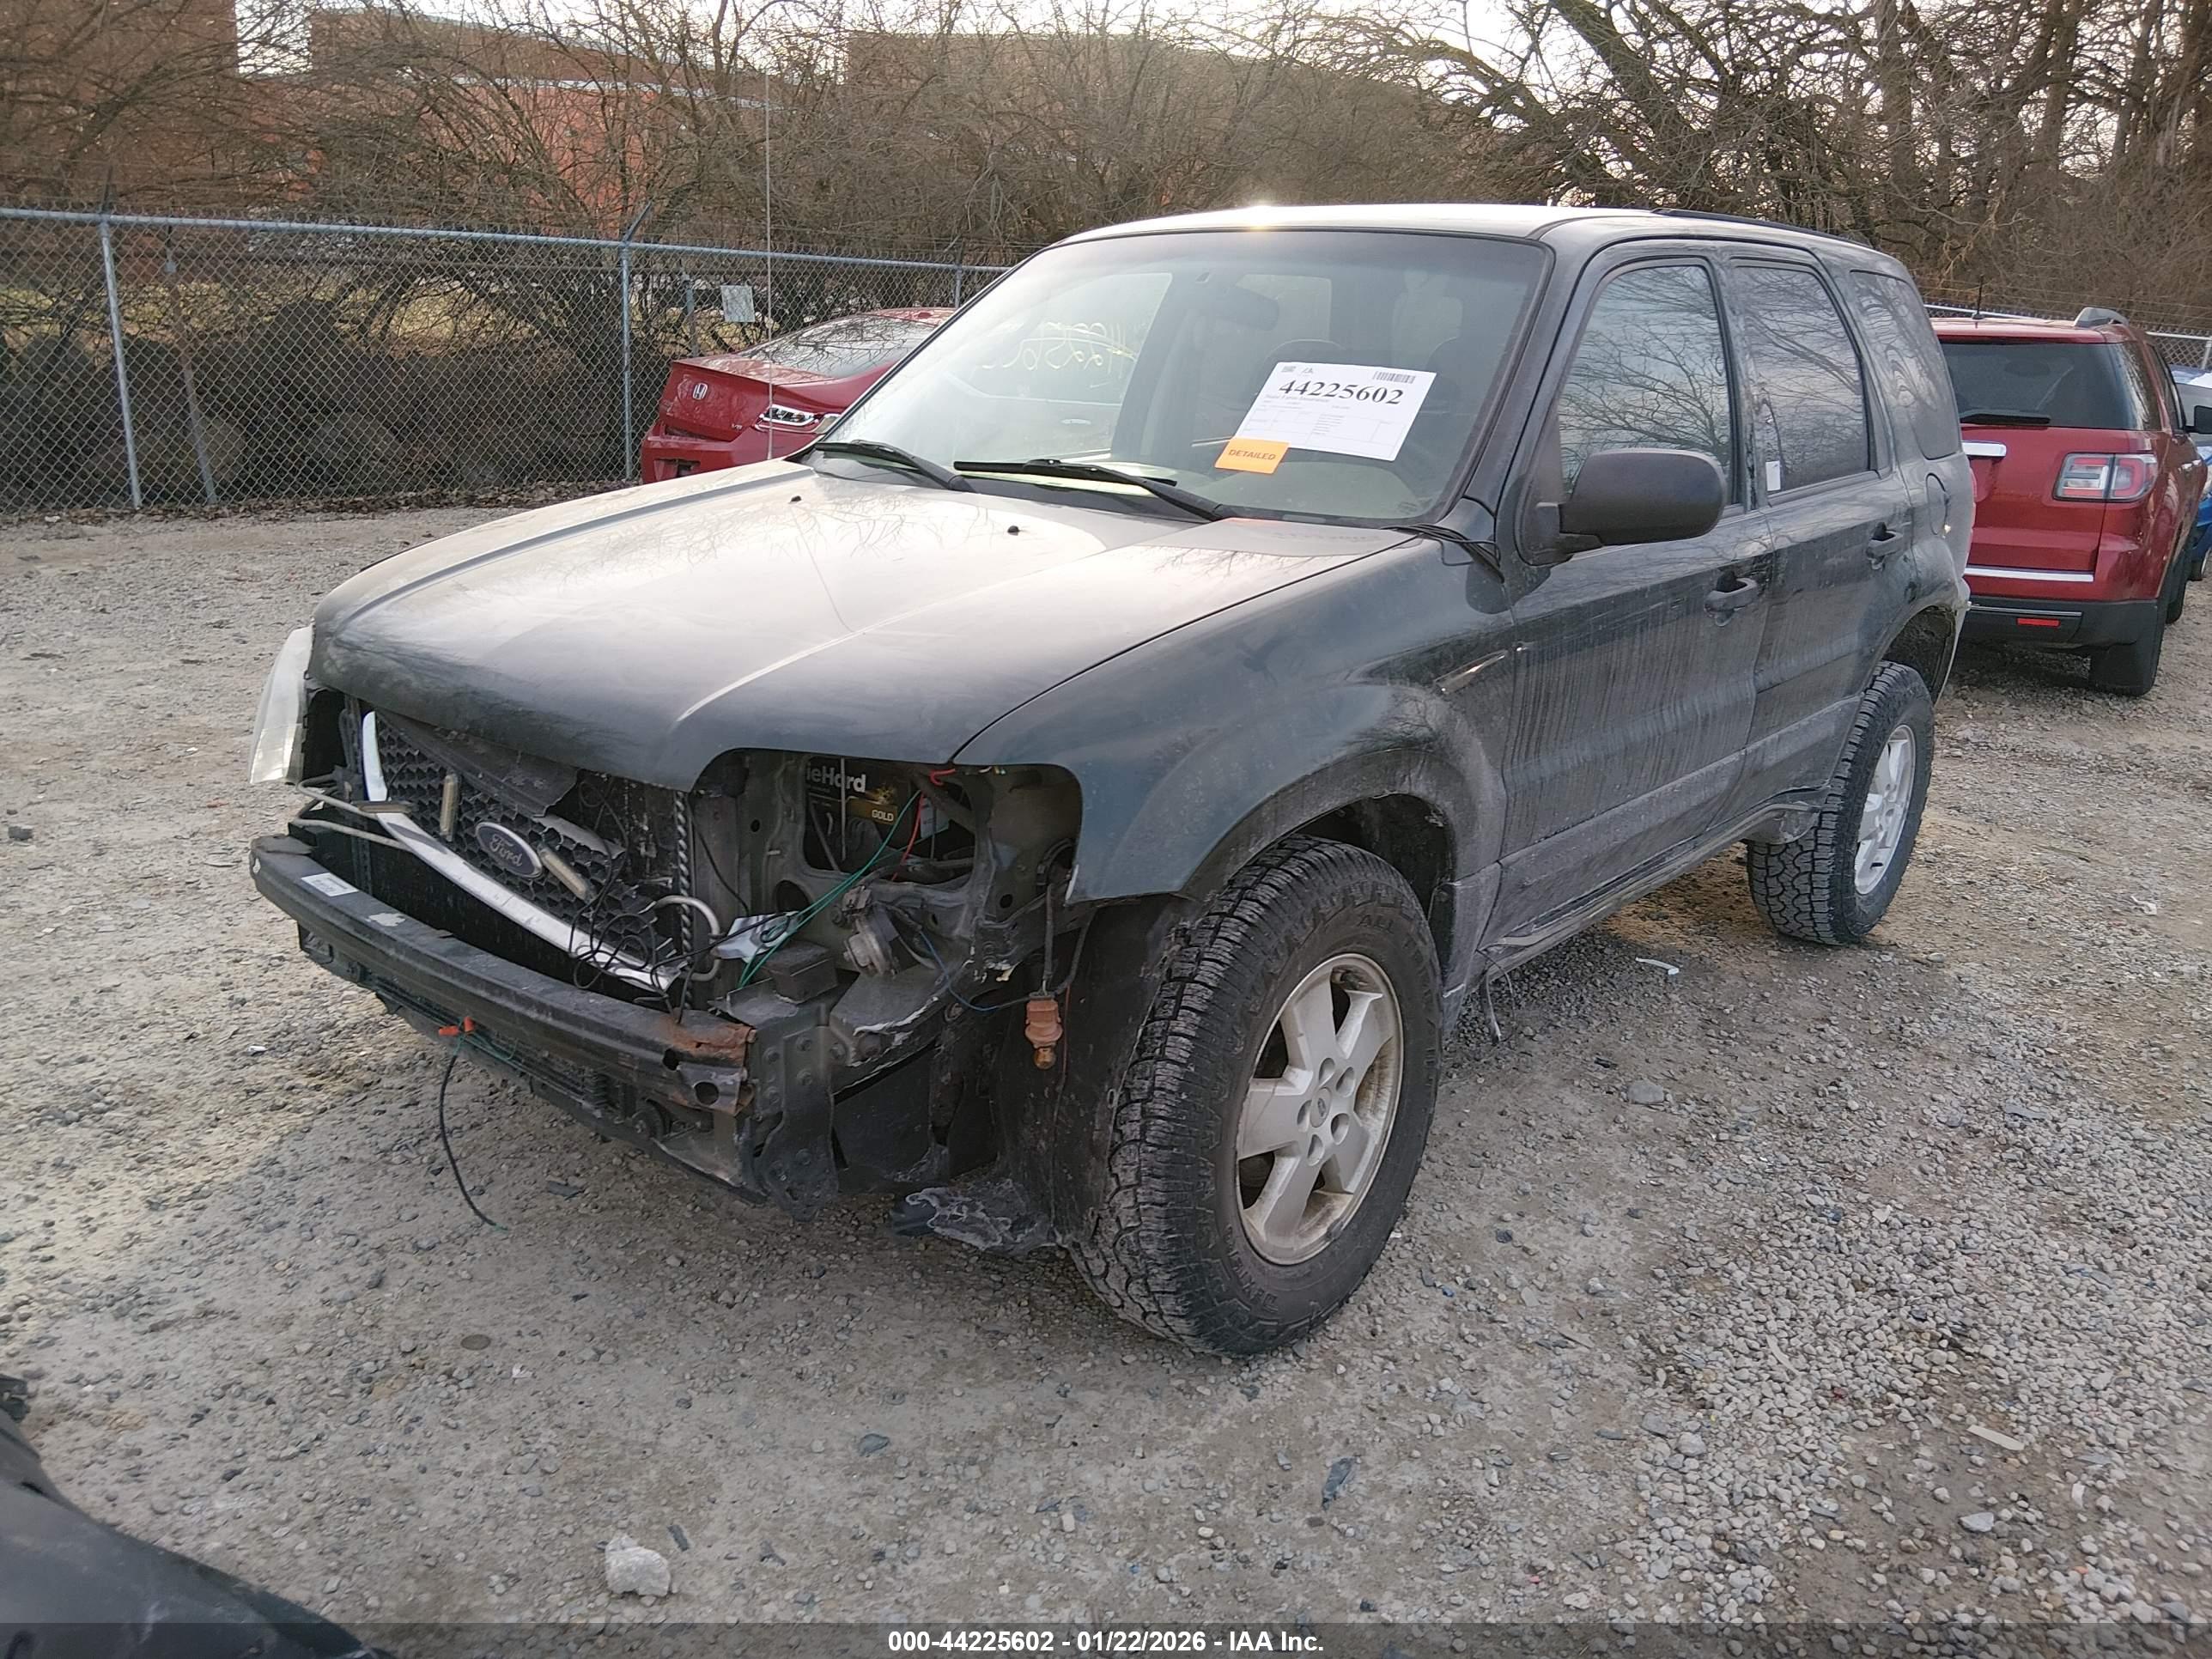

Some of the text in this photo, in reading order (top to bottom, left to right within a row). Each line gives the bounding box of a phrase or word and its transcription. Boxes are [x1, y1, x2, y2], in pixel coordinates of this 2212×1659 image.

[1279, 380, 1404, 405] 44225602
[1229, 449, 1277, 460] DETAILED
[806, 762, 866, 793] ieHard
[872, 809, 895, 822] GOLD
[489, 833, 523, 866] Ford
